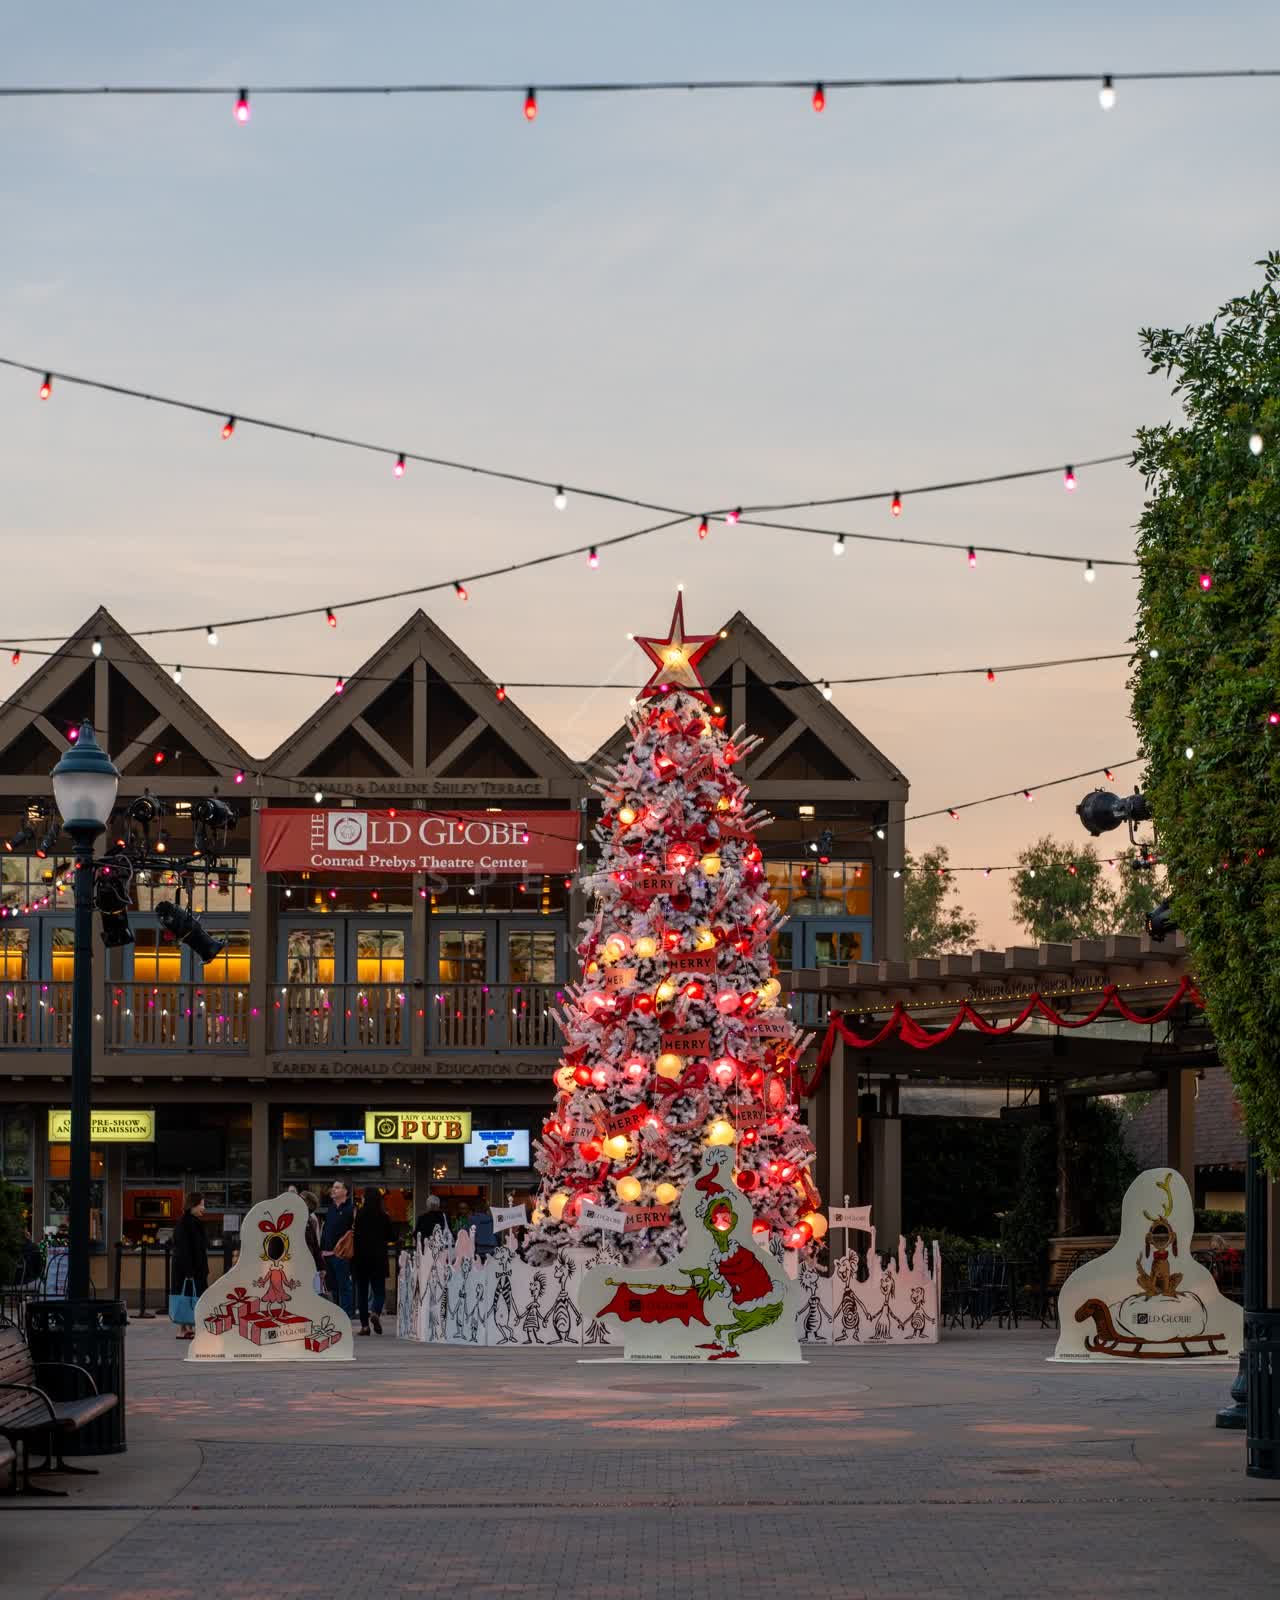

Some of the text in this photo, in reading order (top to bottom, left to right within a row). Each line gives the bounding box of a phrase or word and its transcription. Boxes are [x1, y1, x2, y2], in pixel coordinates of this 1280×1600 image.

[367, 782, 428, 793] DARLENE
[432, 782, 479, 794] SHILEY
[480, 782, 543, 794] TERRACE
[311, 813, 325, 851] THE
[418, 817, 529, 846] GLOBE
[311, 854, 529, 871] Conrad Prebys Theatre Center
[670, 958, 711, 969] MERRY
[664, 1039, 706, 1050] MERRY
[272, 1061, 316, 1073] KAREN
[333, 1061, 389, 1073] DONALD
[436, 1061, 510, 1073] EDUCATION
[608, 1112, 647, 1132] MERRY
[401, 1120, 462, 1140] PUB
[626, 1212, 667, 1225] MERRY
